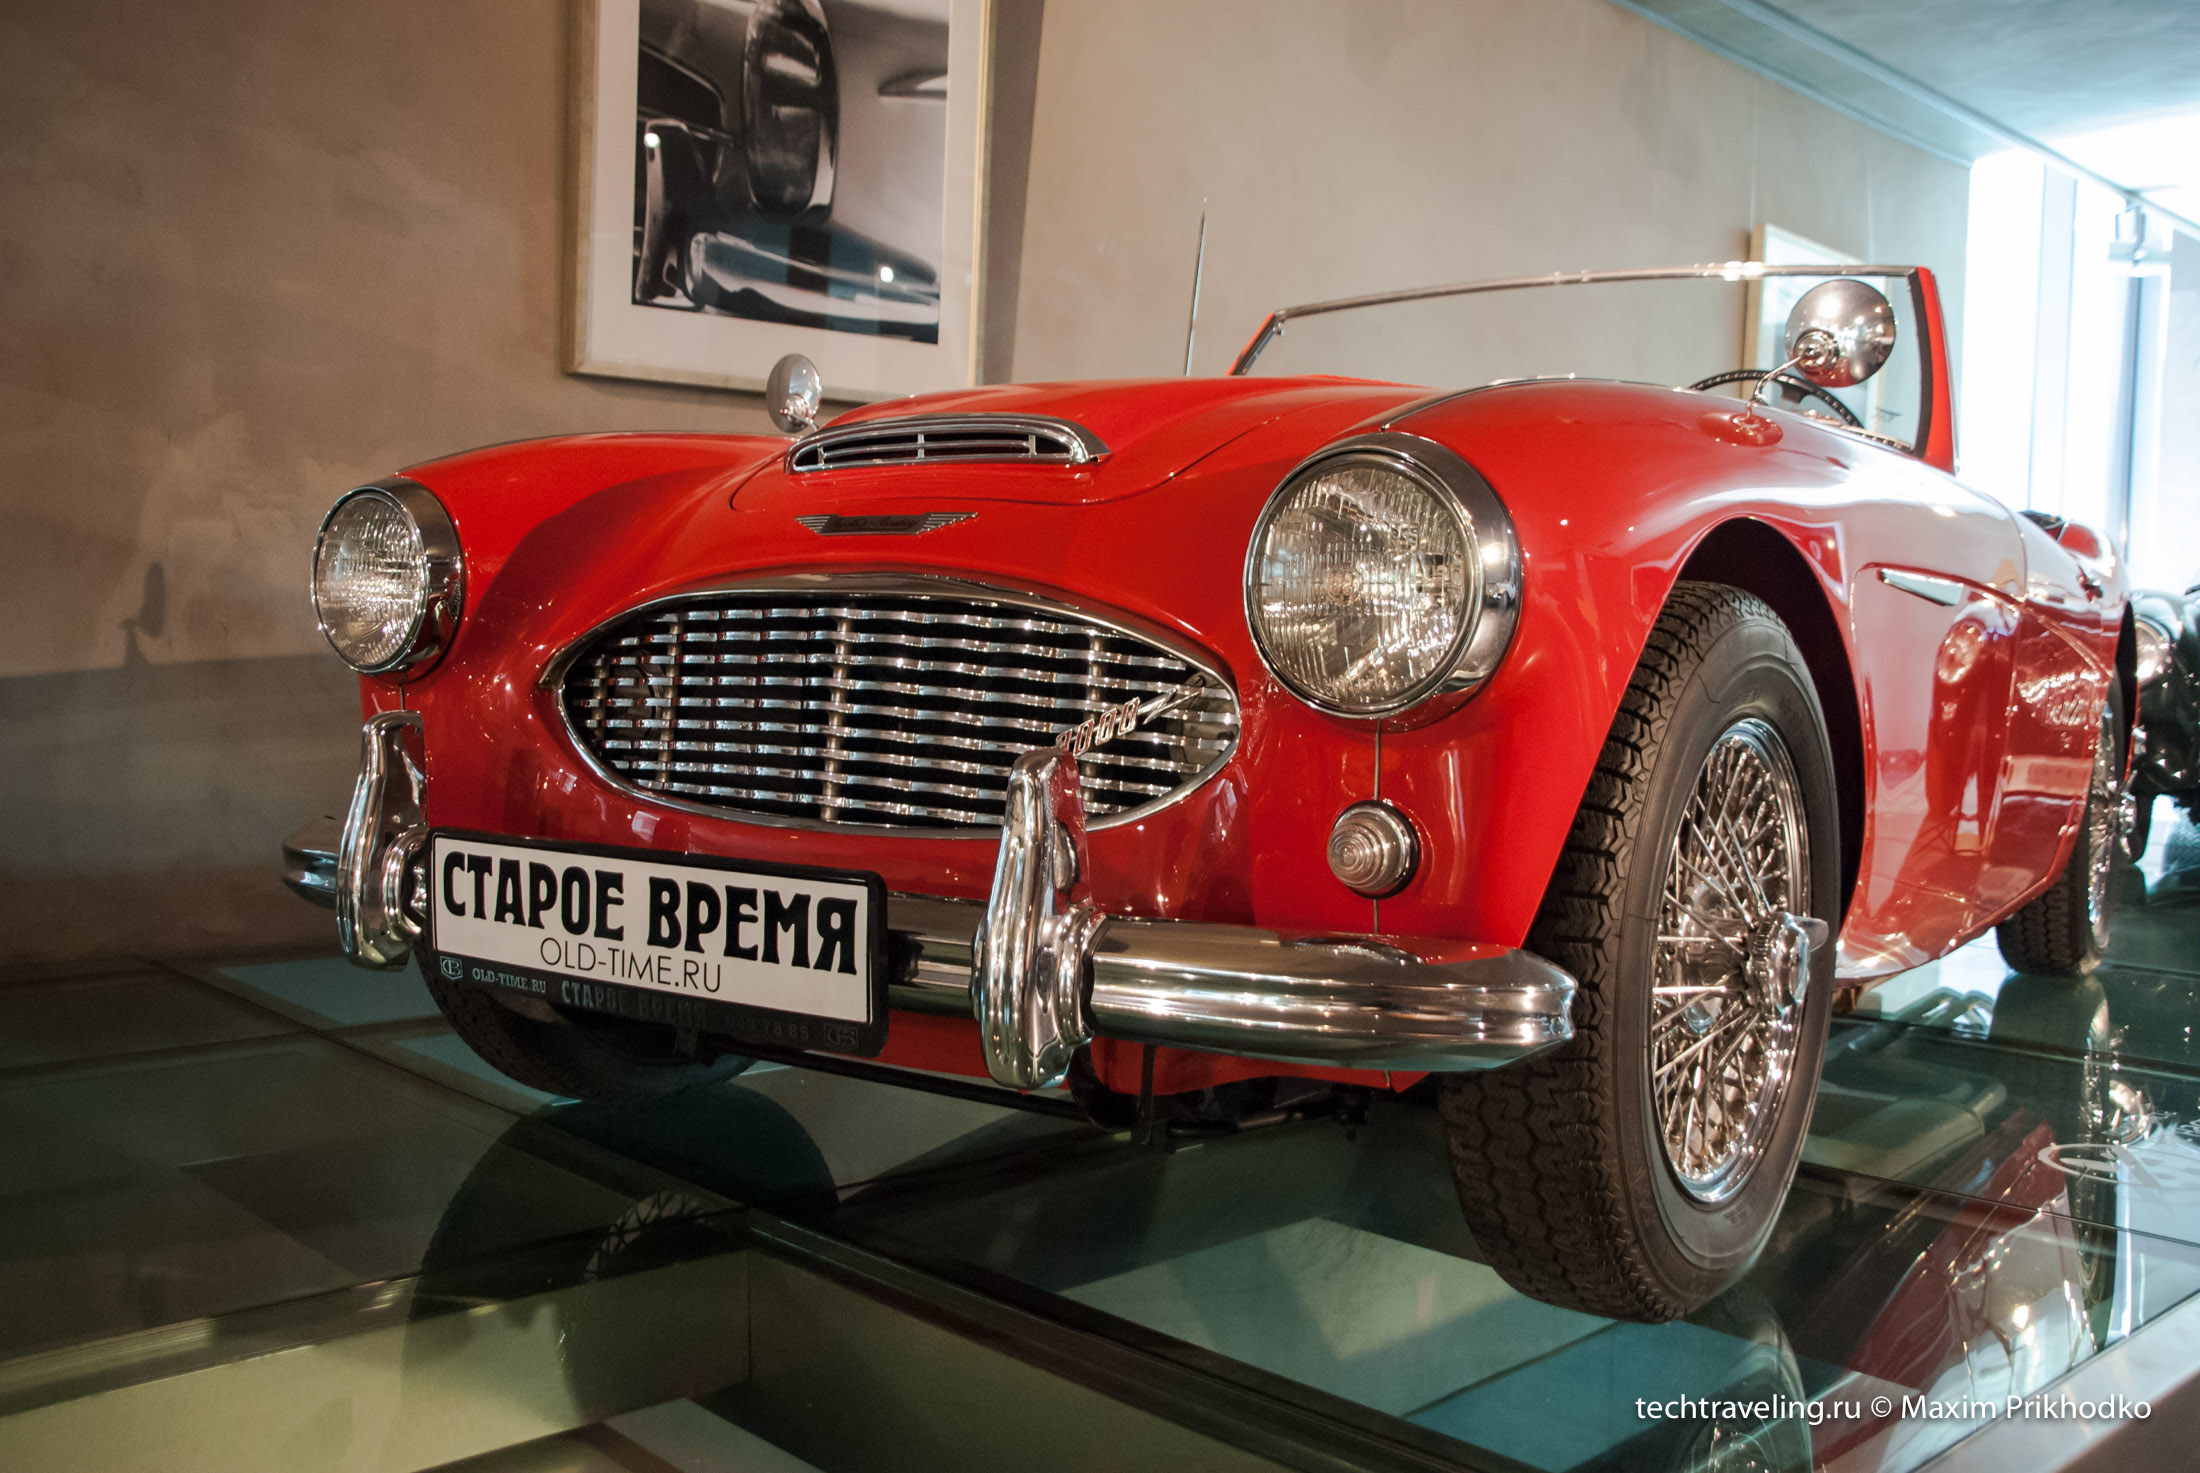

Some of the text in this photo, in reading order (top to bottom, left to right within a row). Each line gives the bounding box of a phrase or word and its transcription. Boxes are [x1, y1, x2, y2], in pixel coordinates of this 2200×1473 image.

[443, 850, 858, 975] СТАРОЕ ВРЕМЯ
[472, 967, 547, 993] OLD-TIME.RU
[540, 937, 722, 993] OLD-TIME.RU
